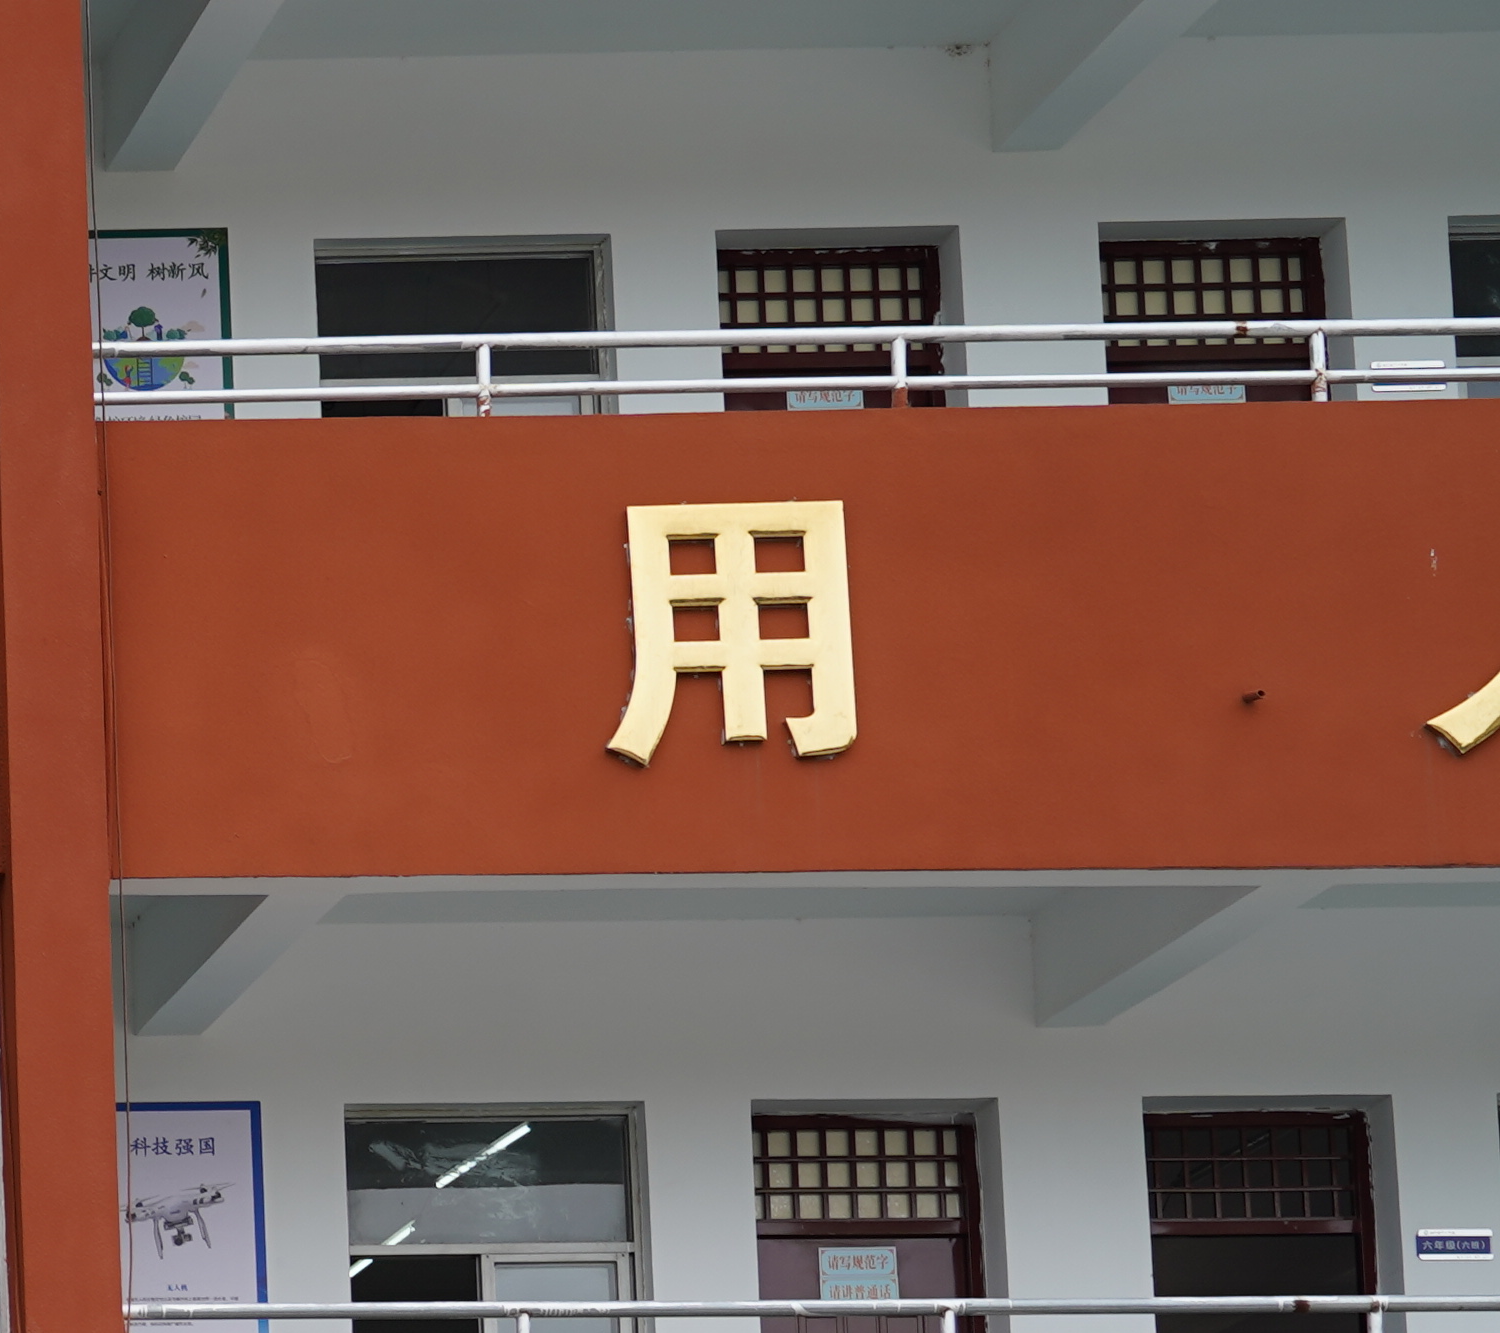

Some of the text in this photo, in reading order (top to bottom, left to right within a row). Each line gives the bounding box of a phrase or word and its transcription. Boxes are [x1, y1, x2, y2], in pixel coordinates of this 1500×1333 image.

[146, 262, 209, 282] 树新风
[606, 499, 859, 767] 用
[130, 1136, 216, 1156] 科技强国
[827, 1253, 889, 1271] 请写规范字
[829, 1284, 892, 1300] 请讲普通话
